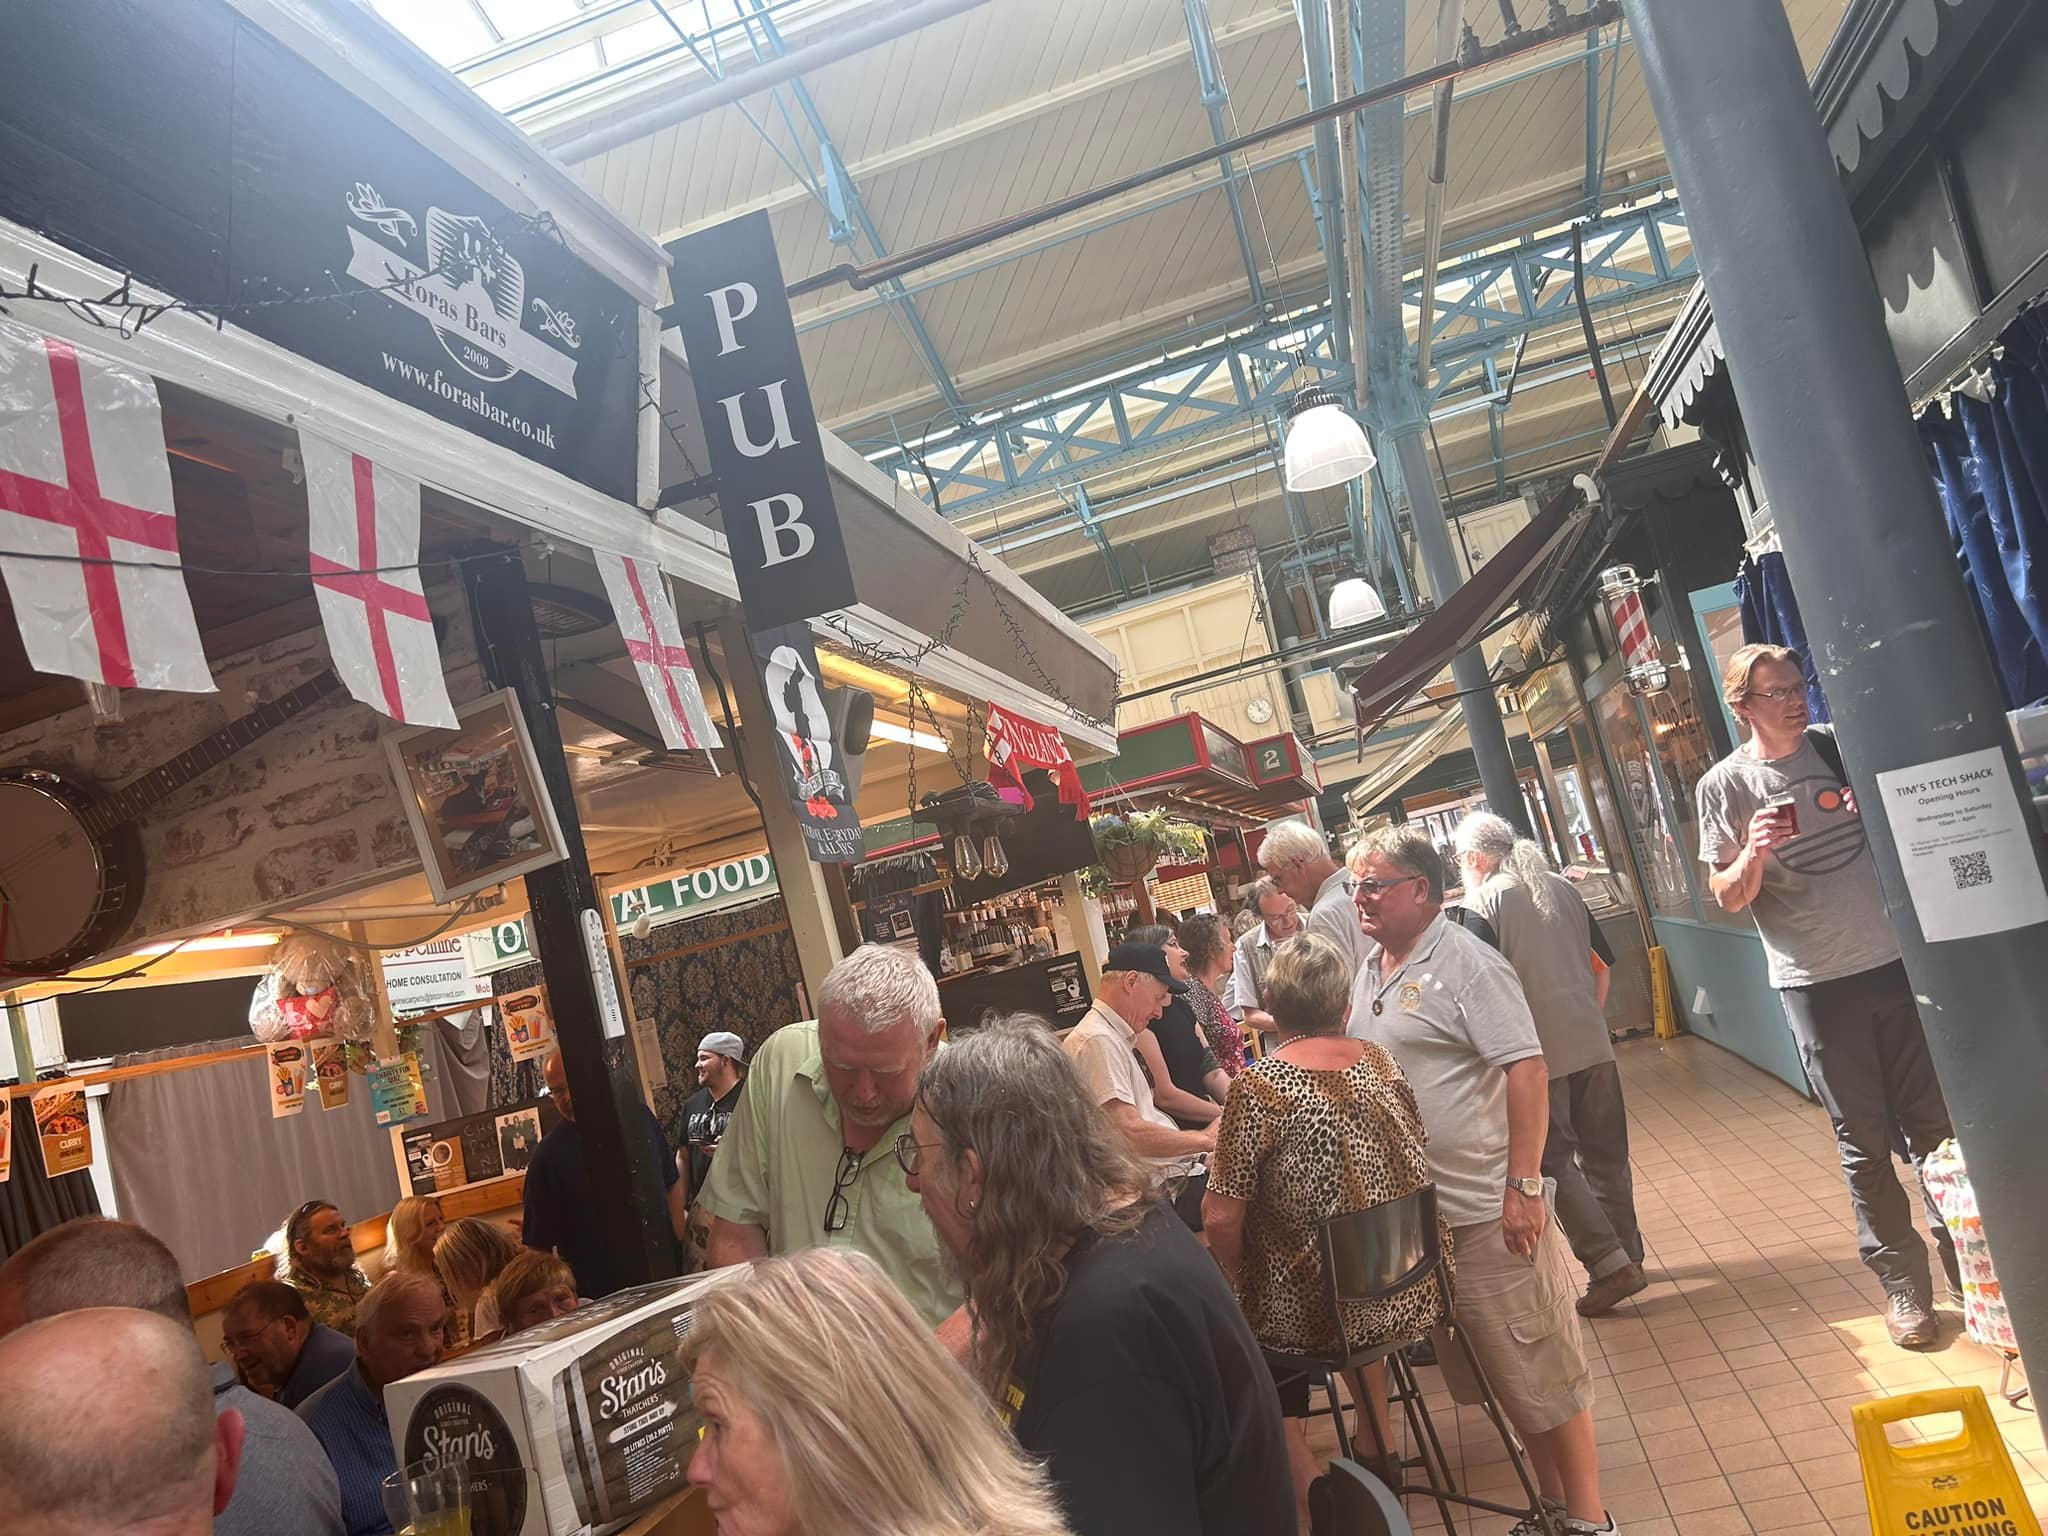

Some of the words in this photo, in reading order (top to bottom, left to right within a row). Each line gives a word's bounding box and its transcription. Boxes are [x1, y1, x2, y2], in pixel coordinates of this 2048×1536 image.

[404, 266, 458, 322] Foras
[464, 303, 507, 349] Bars
[463, 345, 489, 370] 2008
[381, 351, 556, 450] www.forasbar.co.uk
[703, 281, 816, 569] PUB
[1264, 749, 1280, 773] 2
[1896, 783, 1927, 797] TIM'S
[1928, 776, 1958, 791] TECH
[1960, 768, 1994, 784] SHACK
[1918, 792, 1954, 806] Opening
[1956, 787, 1981, 798] Hours
[672, 855, 775, 908] FOOD
[386, 977, 408, 989] HOME
[410, 971, 462, 987] CONSULTATION
[600, 1357, 667, 1420] Stan's
[621, 1392, 660, 1419] THATCHERS
[423, 1423, 494, 1476] Stan's
[1905, 1498, 2006, 1530] CAUTION
[1909, 1520, 2018, 1536] NING
